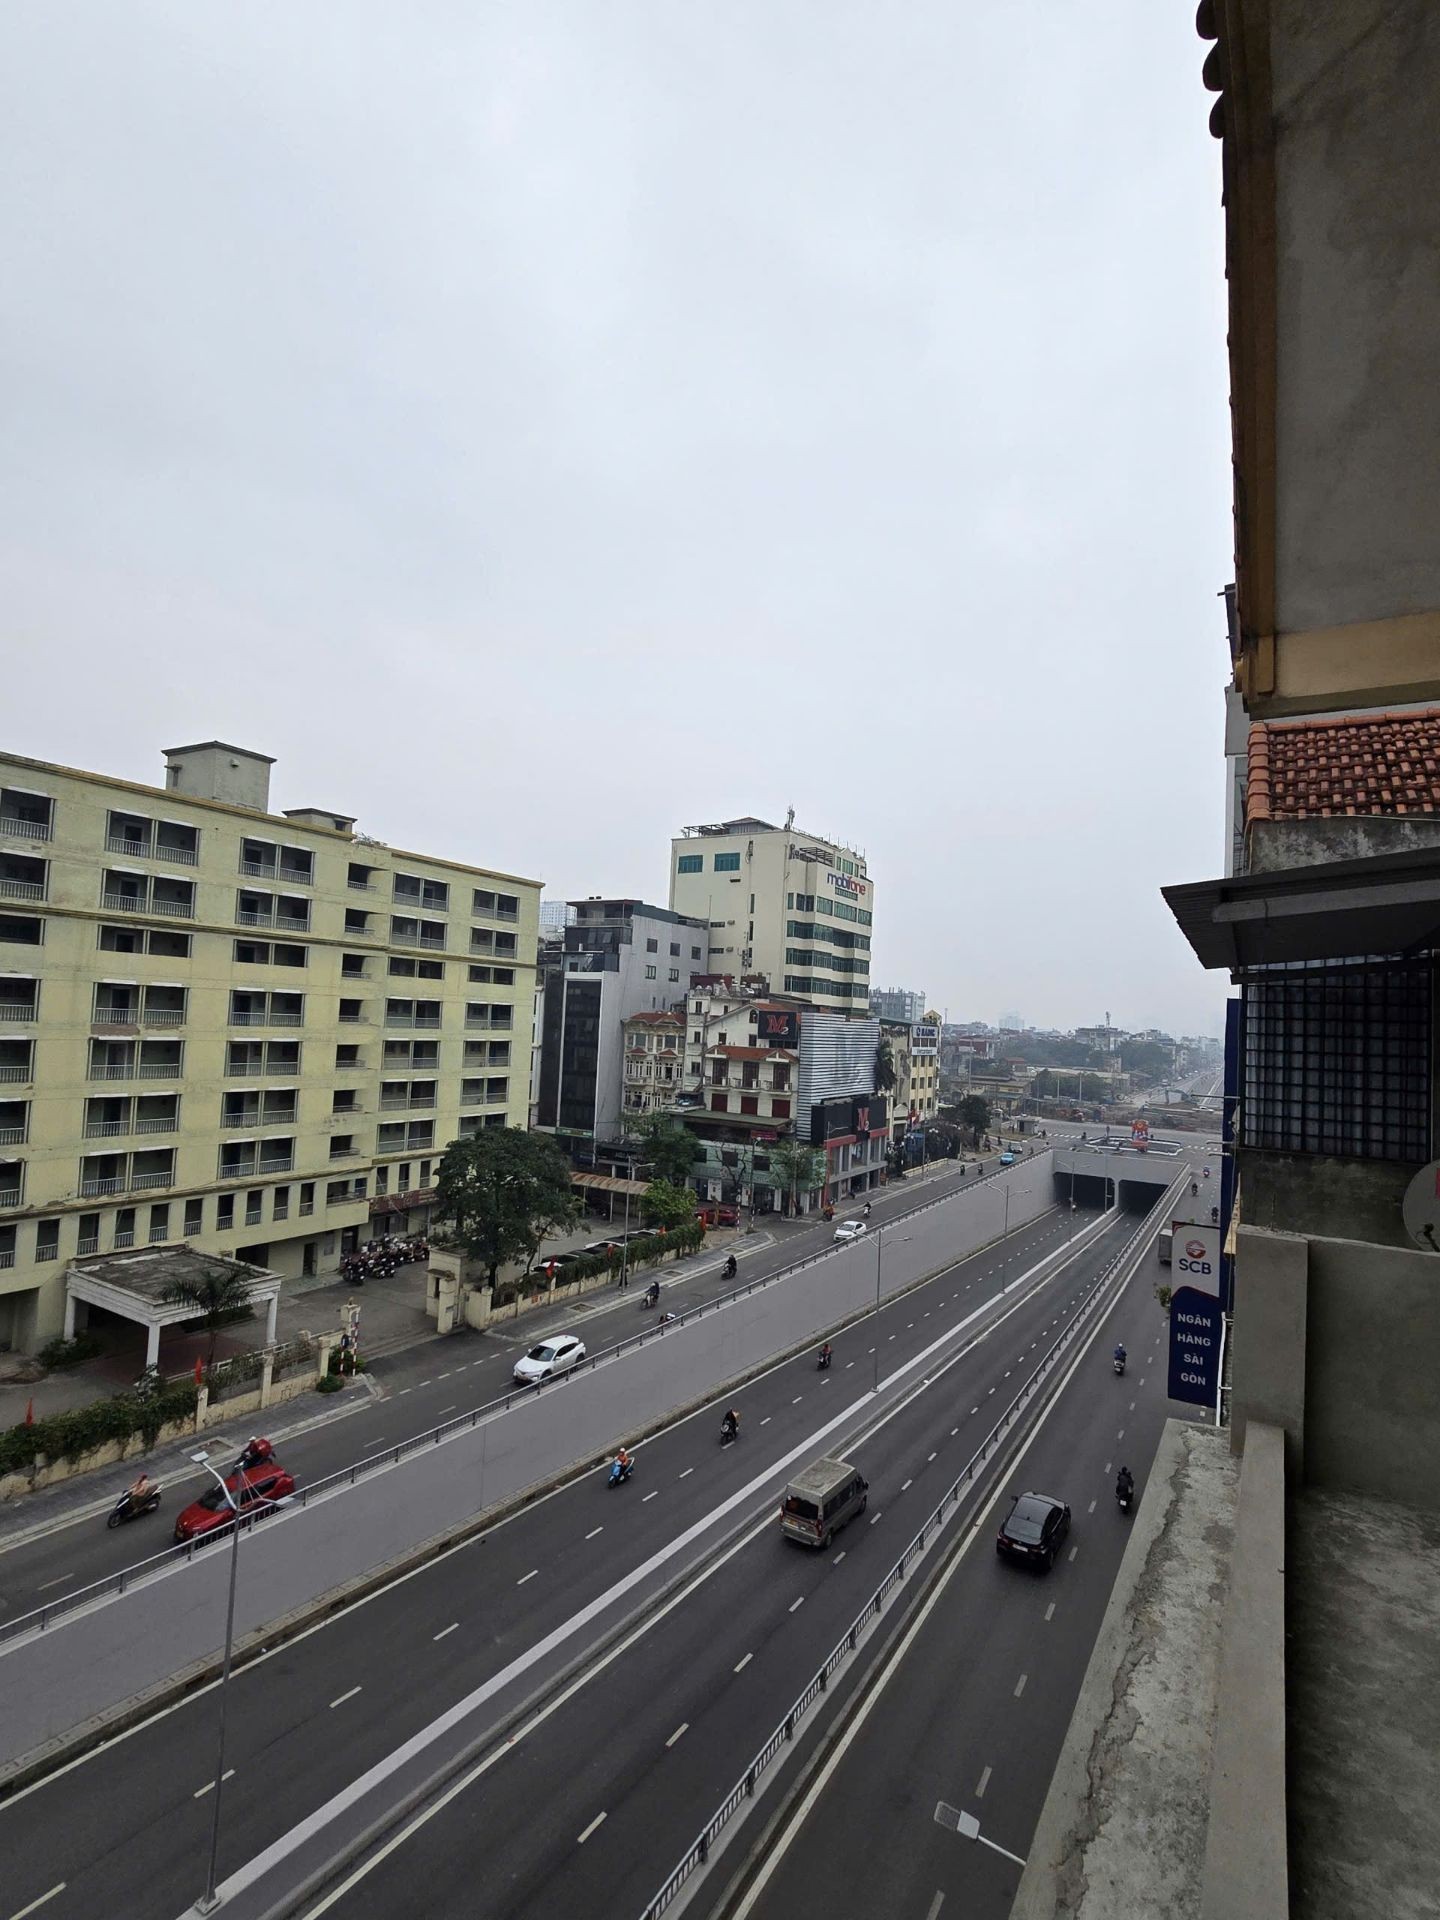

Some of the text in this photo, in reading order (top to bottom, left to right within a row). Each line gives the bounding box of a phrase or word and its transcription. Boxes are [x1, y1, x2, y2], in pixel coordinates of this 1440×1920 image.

[1179, 1258, 1212, 1275] SCB
[1177, 1313, 1211, 1328] NGÂN
[1177, 1332, 1211, 1346] HÀNG
[1183, 1353, 1204, 1366] SÀI
[1180, 1372, 1206, 1386] GÒN
